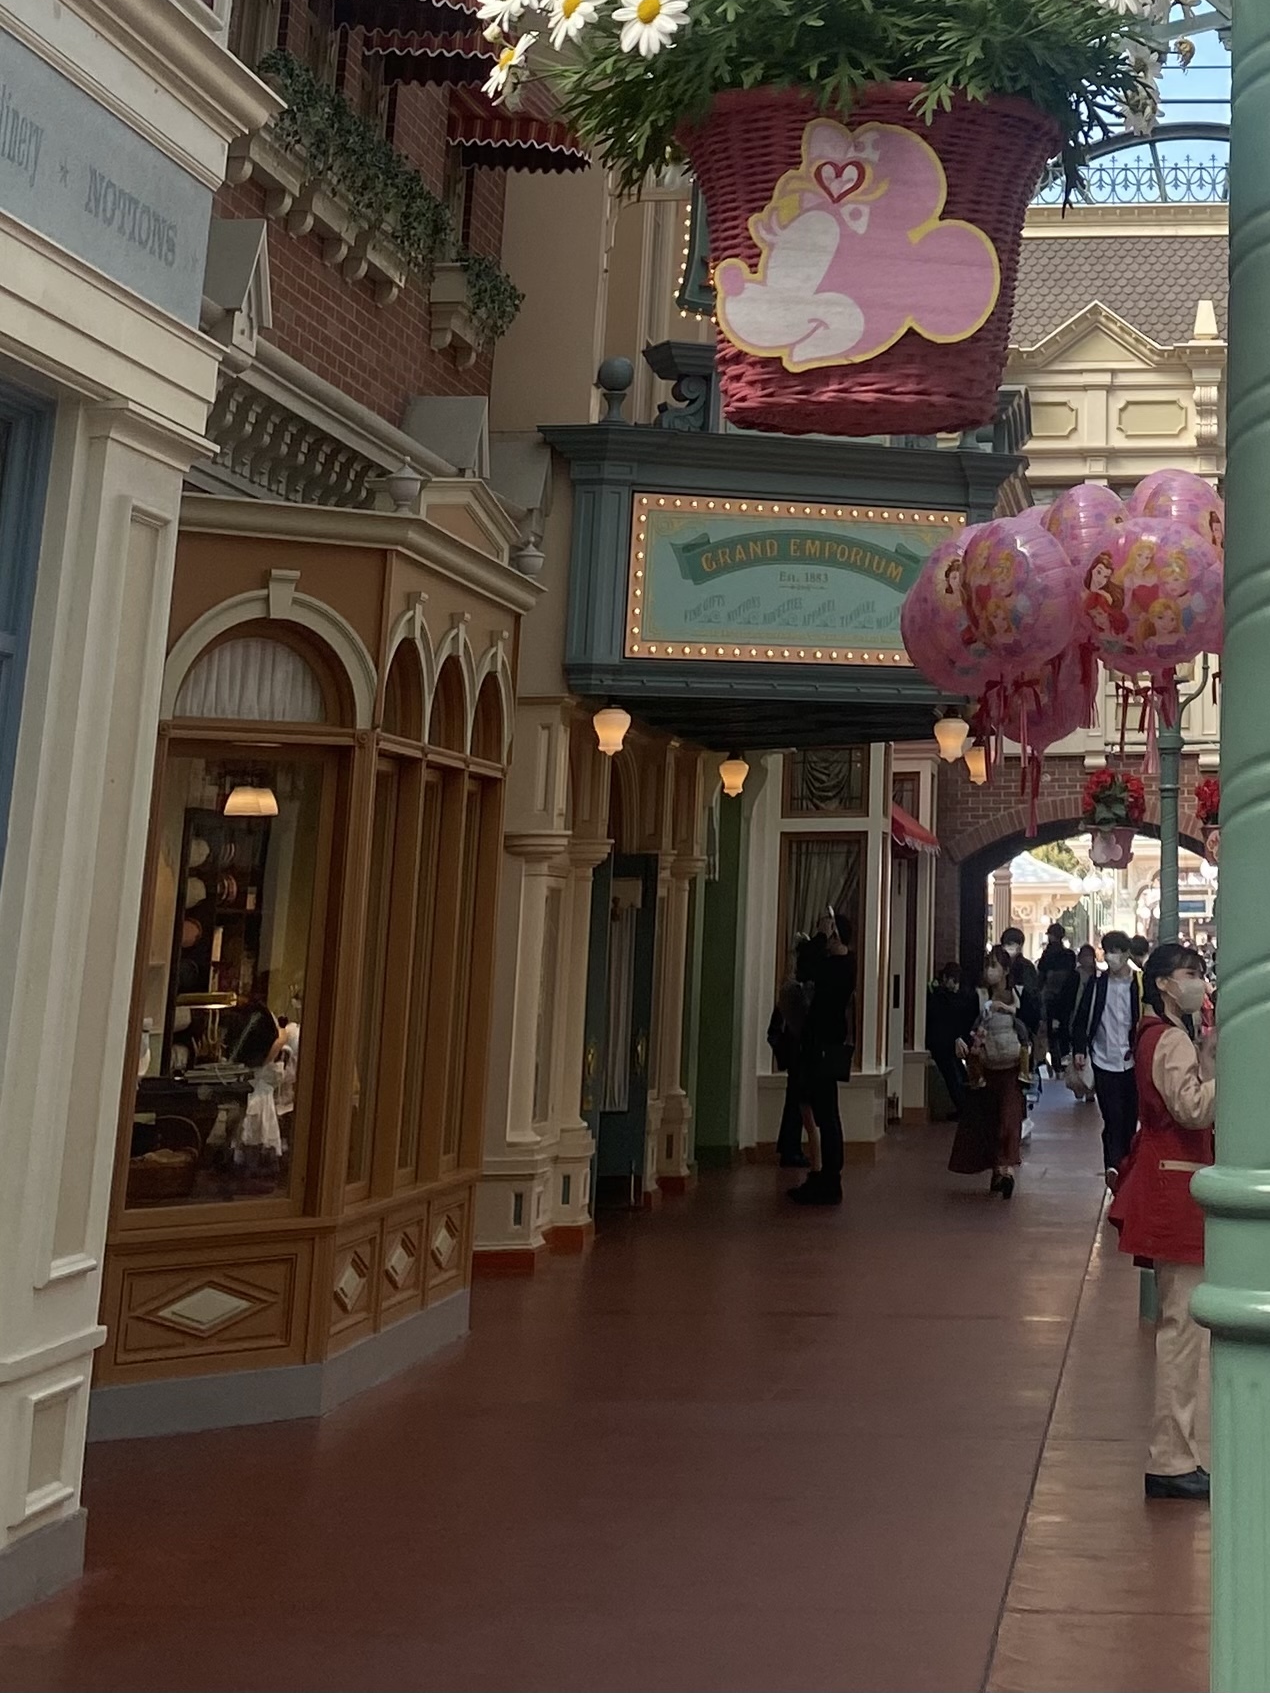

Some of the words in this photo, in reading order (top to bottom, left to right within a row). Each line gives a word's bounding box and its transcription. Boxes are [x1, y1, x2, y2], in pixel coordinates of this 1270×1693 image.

[84, 165, 178, 268] NOTIONS
[701, 539, 779, 572] GRAND
[790, 538, 904, 583] EMPORIUM
